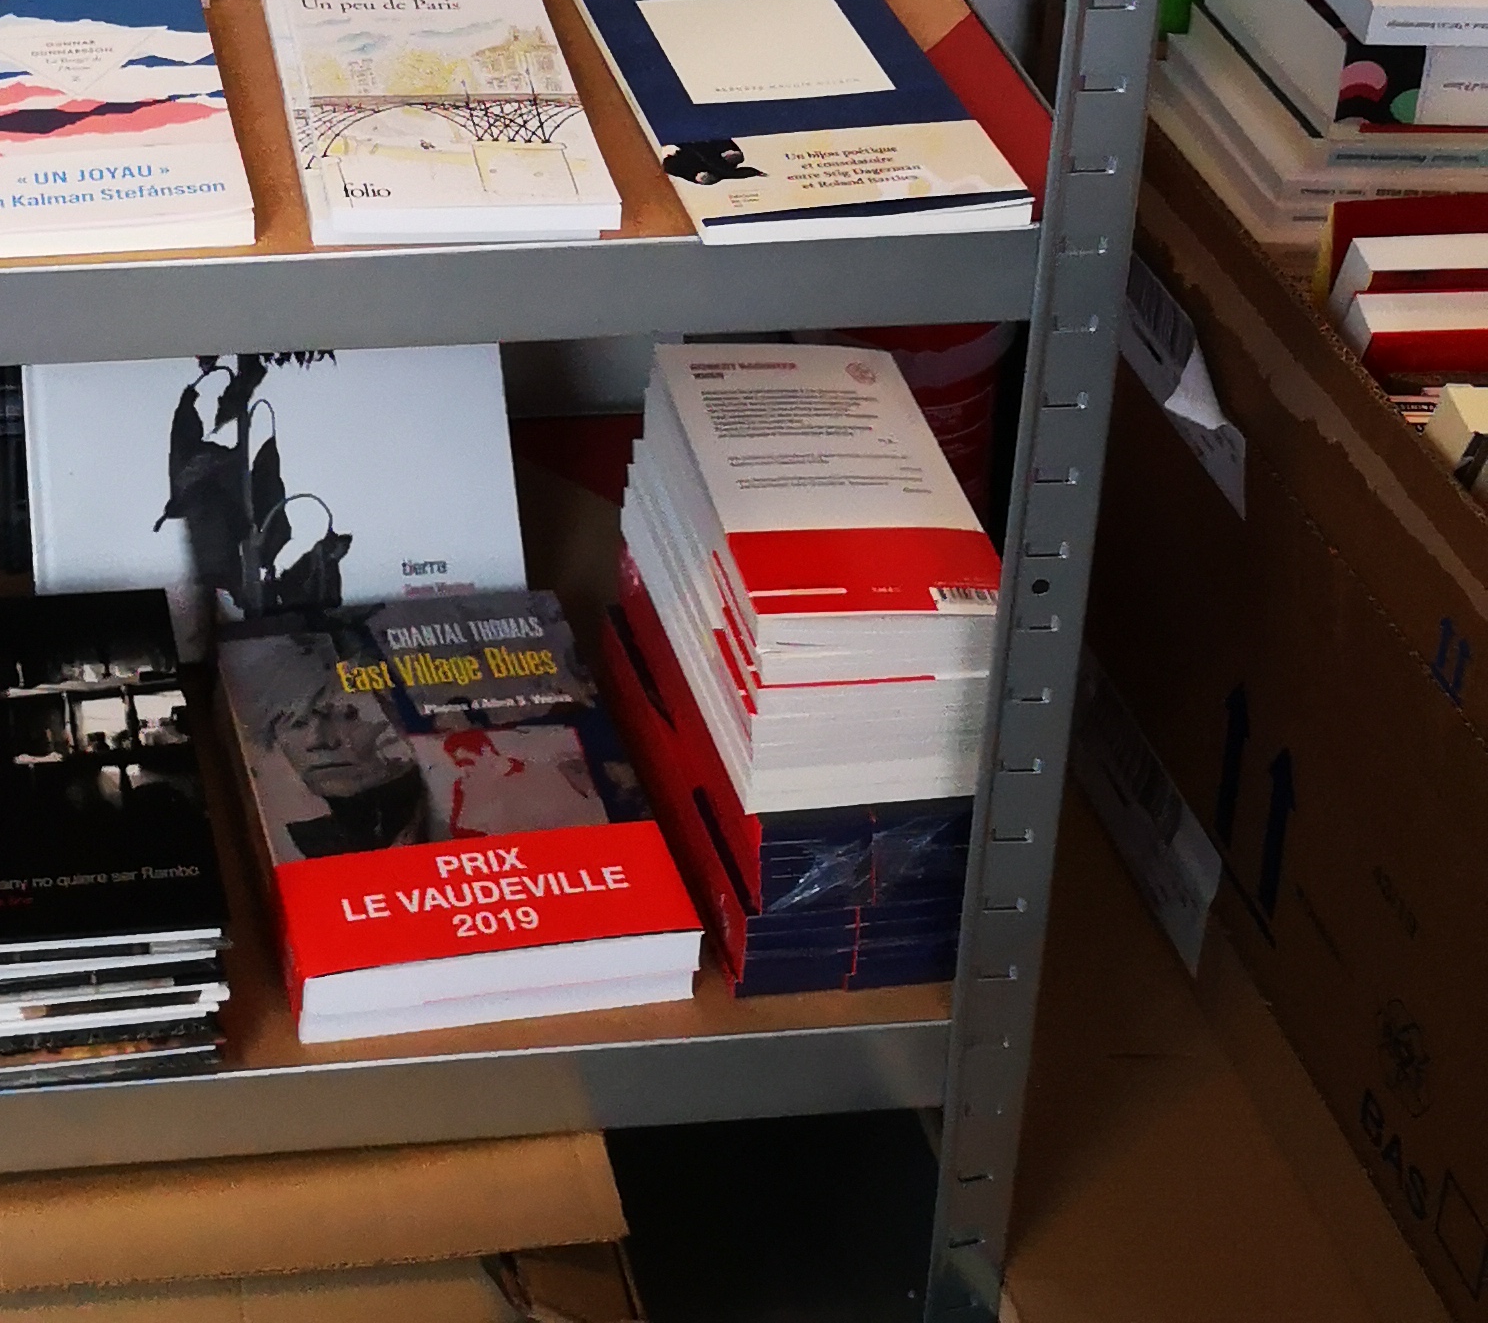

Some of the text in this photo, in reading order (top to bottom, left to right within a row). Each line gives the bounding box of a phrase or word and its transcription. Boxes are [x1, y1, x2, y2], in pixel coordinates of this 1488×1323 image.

[339, 0, 377, 14] peu
[784, 152, 806, 162] Un
[806, 149, 841, 160] bijou
[800, 161, 815, 171] et
[33, 164, 153, 186] UN JOYAU
[786, 163, 923, 182] entre Stig Dagerman
[801, 180, 816, 191] et
[817, 176, 866, 190] Roland
[11, 190, 96, 208] Kalman
[100, 180, 228, 203] Stefánsson
[342, 181, 392, 200] folio
[386, 615, 545, 650] CHANTAL THOMAS
[335, 645, 558, 695] East Village Blues
[434, 846, 528, 879] PRIX
[32, 876, 54, 889] no
[56, 873, 109, 889] quiere
[110, 871, 139, 883] ser
[140, 864, 201, 881] Rambo
[340, 865, 632, 923] LE VAUDEVILLE
[451, 905, 540, 938] 2019
